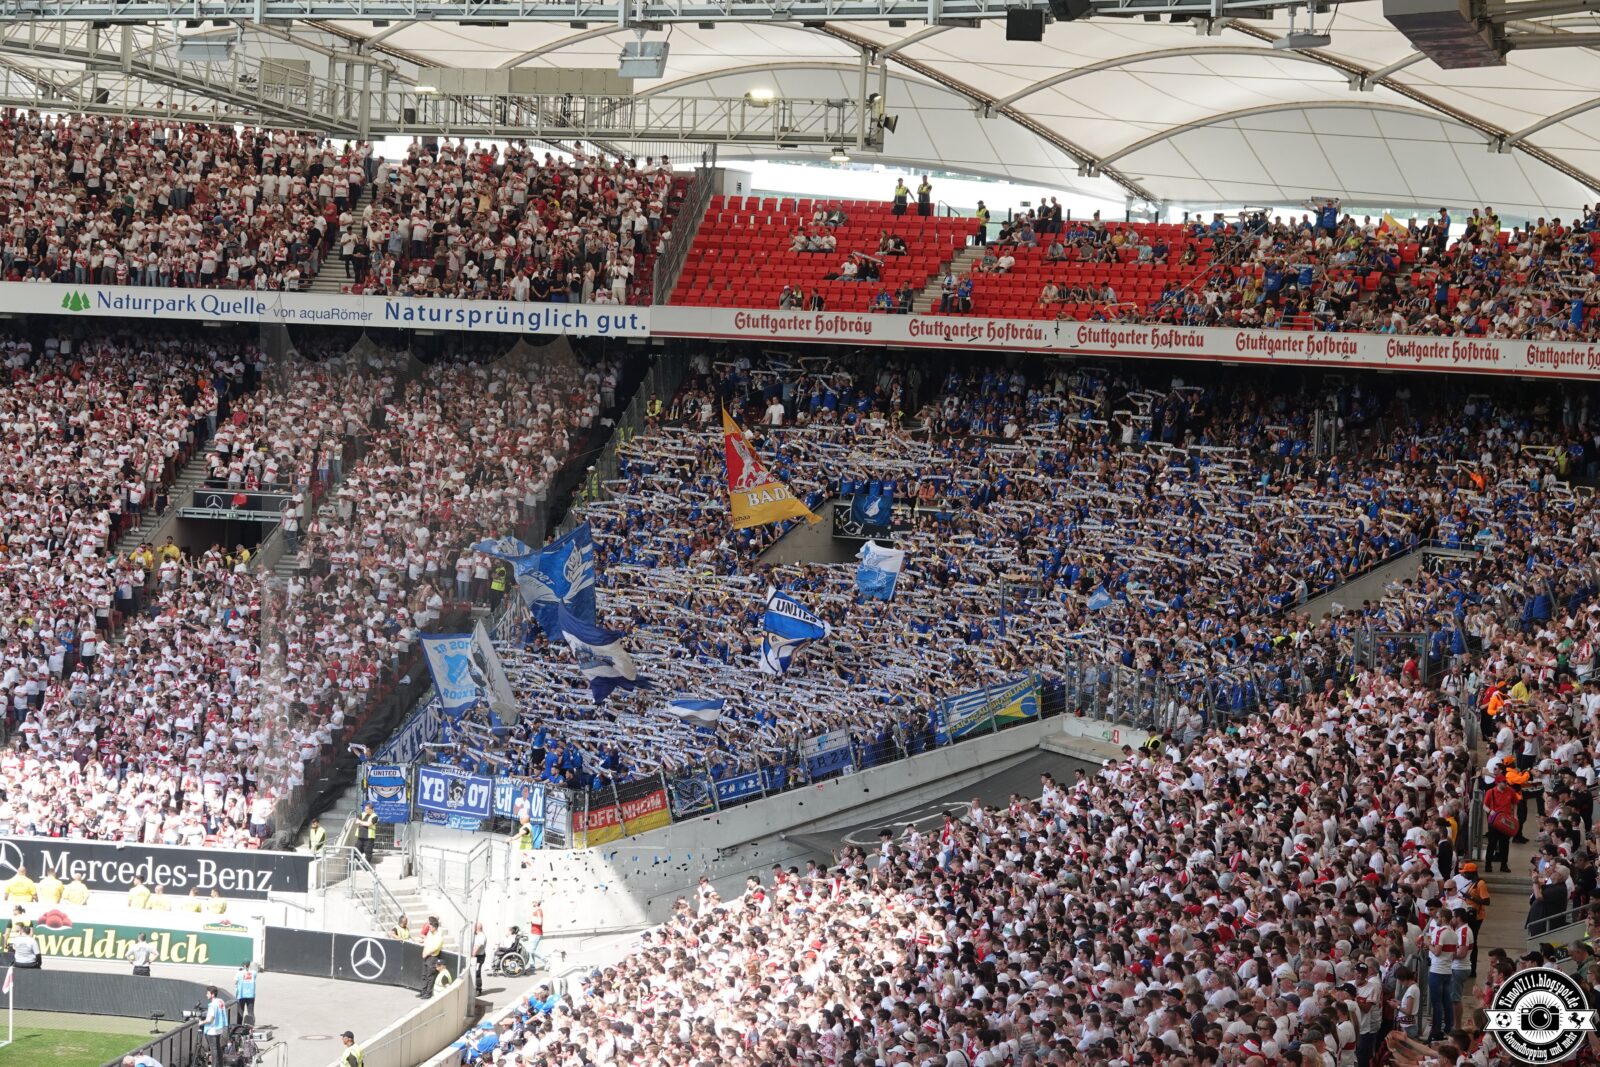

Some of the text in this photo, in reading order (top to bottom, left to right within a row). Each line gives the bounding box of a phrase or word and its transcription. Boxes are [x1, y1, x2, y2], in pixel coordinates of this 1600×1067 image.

[97, 290, 373, 322] Naturpark Quelle von aquaRömer
[385, 301, 646, 333] Natursprünglich gut.
[734, 311, 872, 335] Stuttgarter Hofbräu
[909, 318, 1042, 342] Stuttgarter Hofbräu
[1077, 325, 1204, 349] Stuttgarter Hofbräu
[1235, 331, 1357, 355] Stuttgarter Hofbräu
[1386, 338, 1499, 363] Stuttgarter Hofbräu
[1526, 343, 1585, 369] Stuttgarter
[949, 705, 989, 734] RAICHGAU
[421, 775, 489, 809] YB 07
[39, 850, 273, 892] Mercedes-Benz
[33, 928, 209, 964] waldmilch
